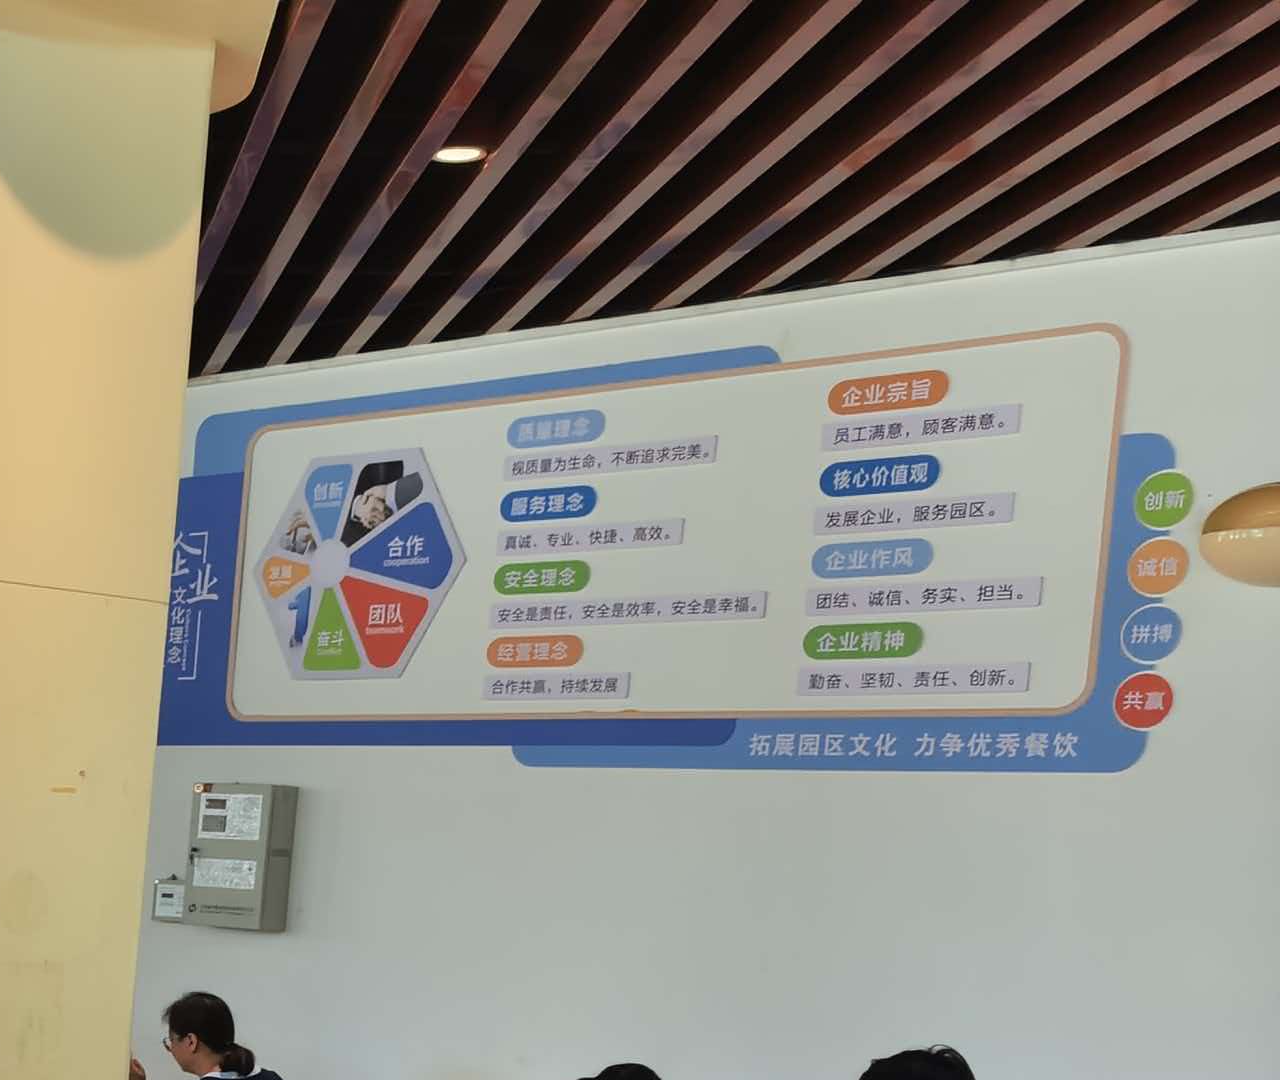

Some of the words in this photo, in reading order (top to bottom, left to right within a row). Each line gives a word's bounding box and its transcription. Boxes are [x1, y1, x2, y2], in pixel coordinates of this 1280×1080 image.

[841, 378, 932, 408] 企业宗旨
[517, 417, 590, 442] 质量理念
[832, 462, 929, 491] 核心价值观
[510, 492, 584, 517] 服务理念
[1144, 489, 1185, 512] 创新
[387, 535, 425, 558] 合作
[383, 556, 430, 567] cooperation
[824, 547, 914, 571] 企业作风
[1136, 558, 1178, 577] 诚信
[504, 567, 577, 589] 安全理念
[815, 584, 1024, 610] 团结、诚信、务实、担当。
[168, 586, 188, 665] 文化理念
[368, 603, 404, 625] 团队
[317, 630, 345, 647] 奋斗
[816, 629, 906, 653] 企业精神
[1130, 623, 1173, 645] 拼搏
[496, 641, 569, 662] 经营理念
[1123, 691, 1165, 711] 共赢
[748, 732, 898, 759] 拓展园区文化
[913, 731, 1081, 759] 力争优秀餐饮
